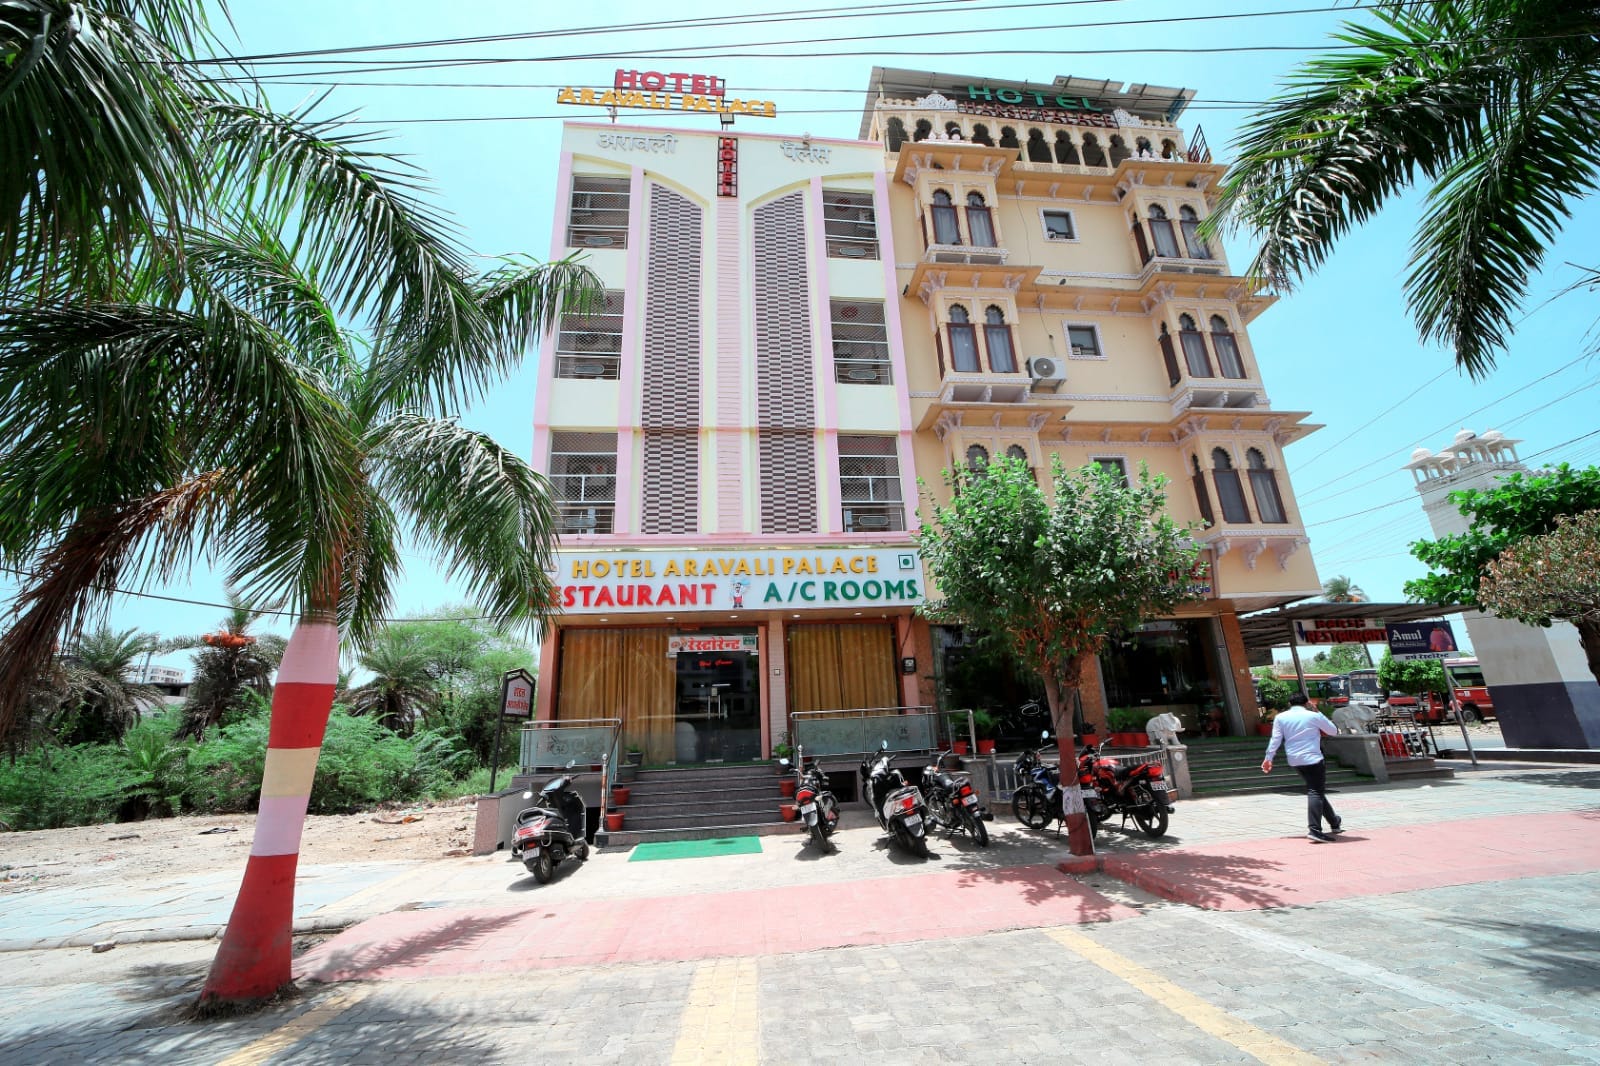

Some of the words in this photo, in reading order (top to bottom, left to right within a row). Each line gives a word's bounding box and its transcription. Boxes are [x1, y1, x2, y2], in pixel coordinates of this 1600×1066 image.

[615, 69, 725, 96] HOTEL
[558, 86, 671, 109] ARAVALI
[682, 94, 776, 117] PALACE
[967, 84, 1103, 111] HOTEL
[964, 101, 1031, 120] HARSH
[1041, 109, 1115, 128] PALACE
[597, 132, 679, 154] अरावली
[722, 138, 735, 196] HOTEL
[572, 559, 656, 578] HOTEL
[663, 557, 775, 577] ARAVALI
[782, 555, 879, 574] PALACE
[530, 583, 717, 607] ESTAURANT
[764, 581, 816, 602] A/C
[825, 579, 918, 600] ROOMS
[1305, 629, 1388, 644] RESTAURANT
[1391, 629, 1423, 641] Amul
